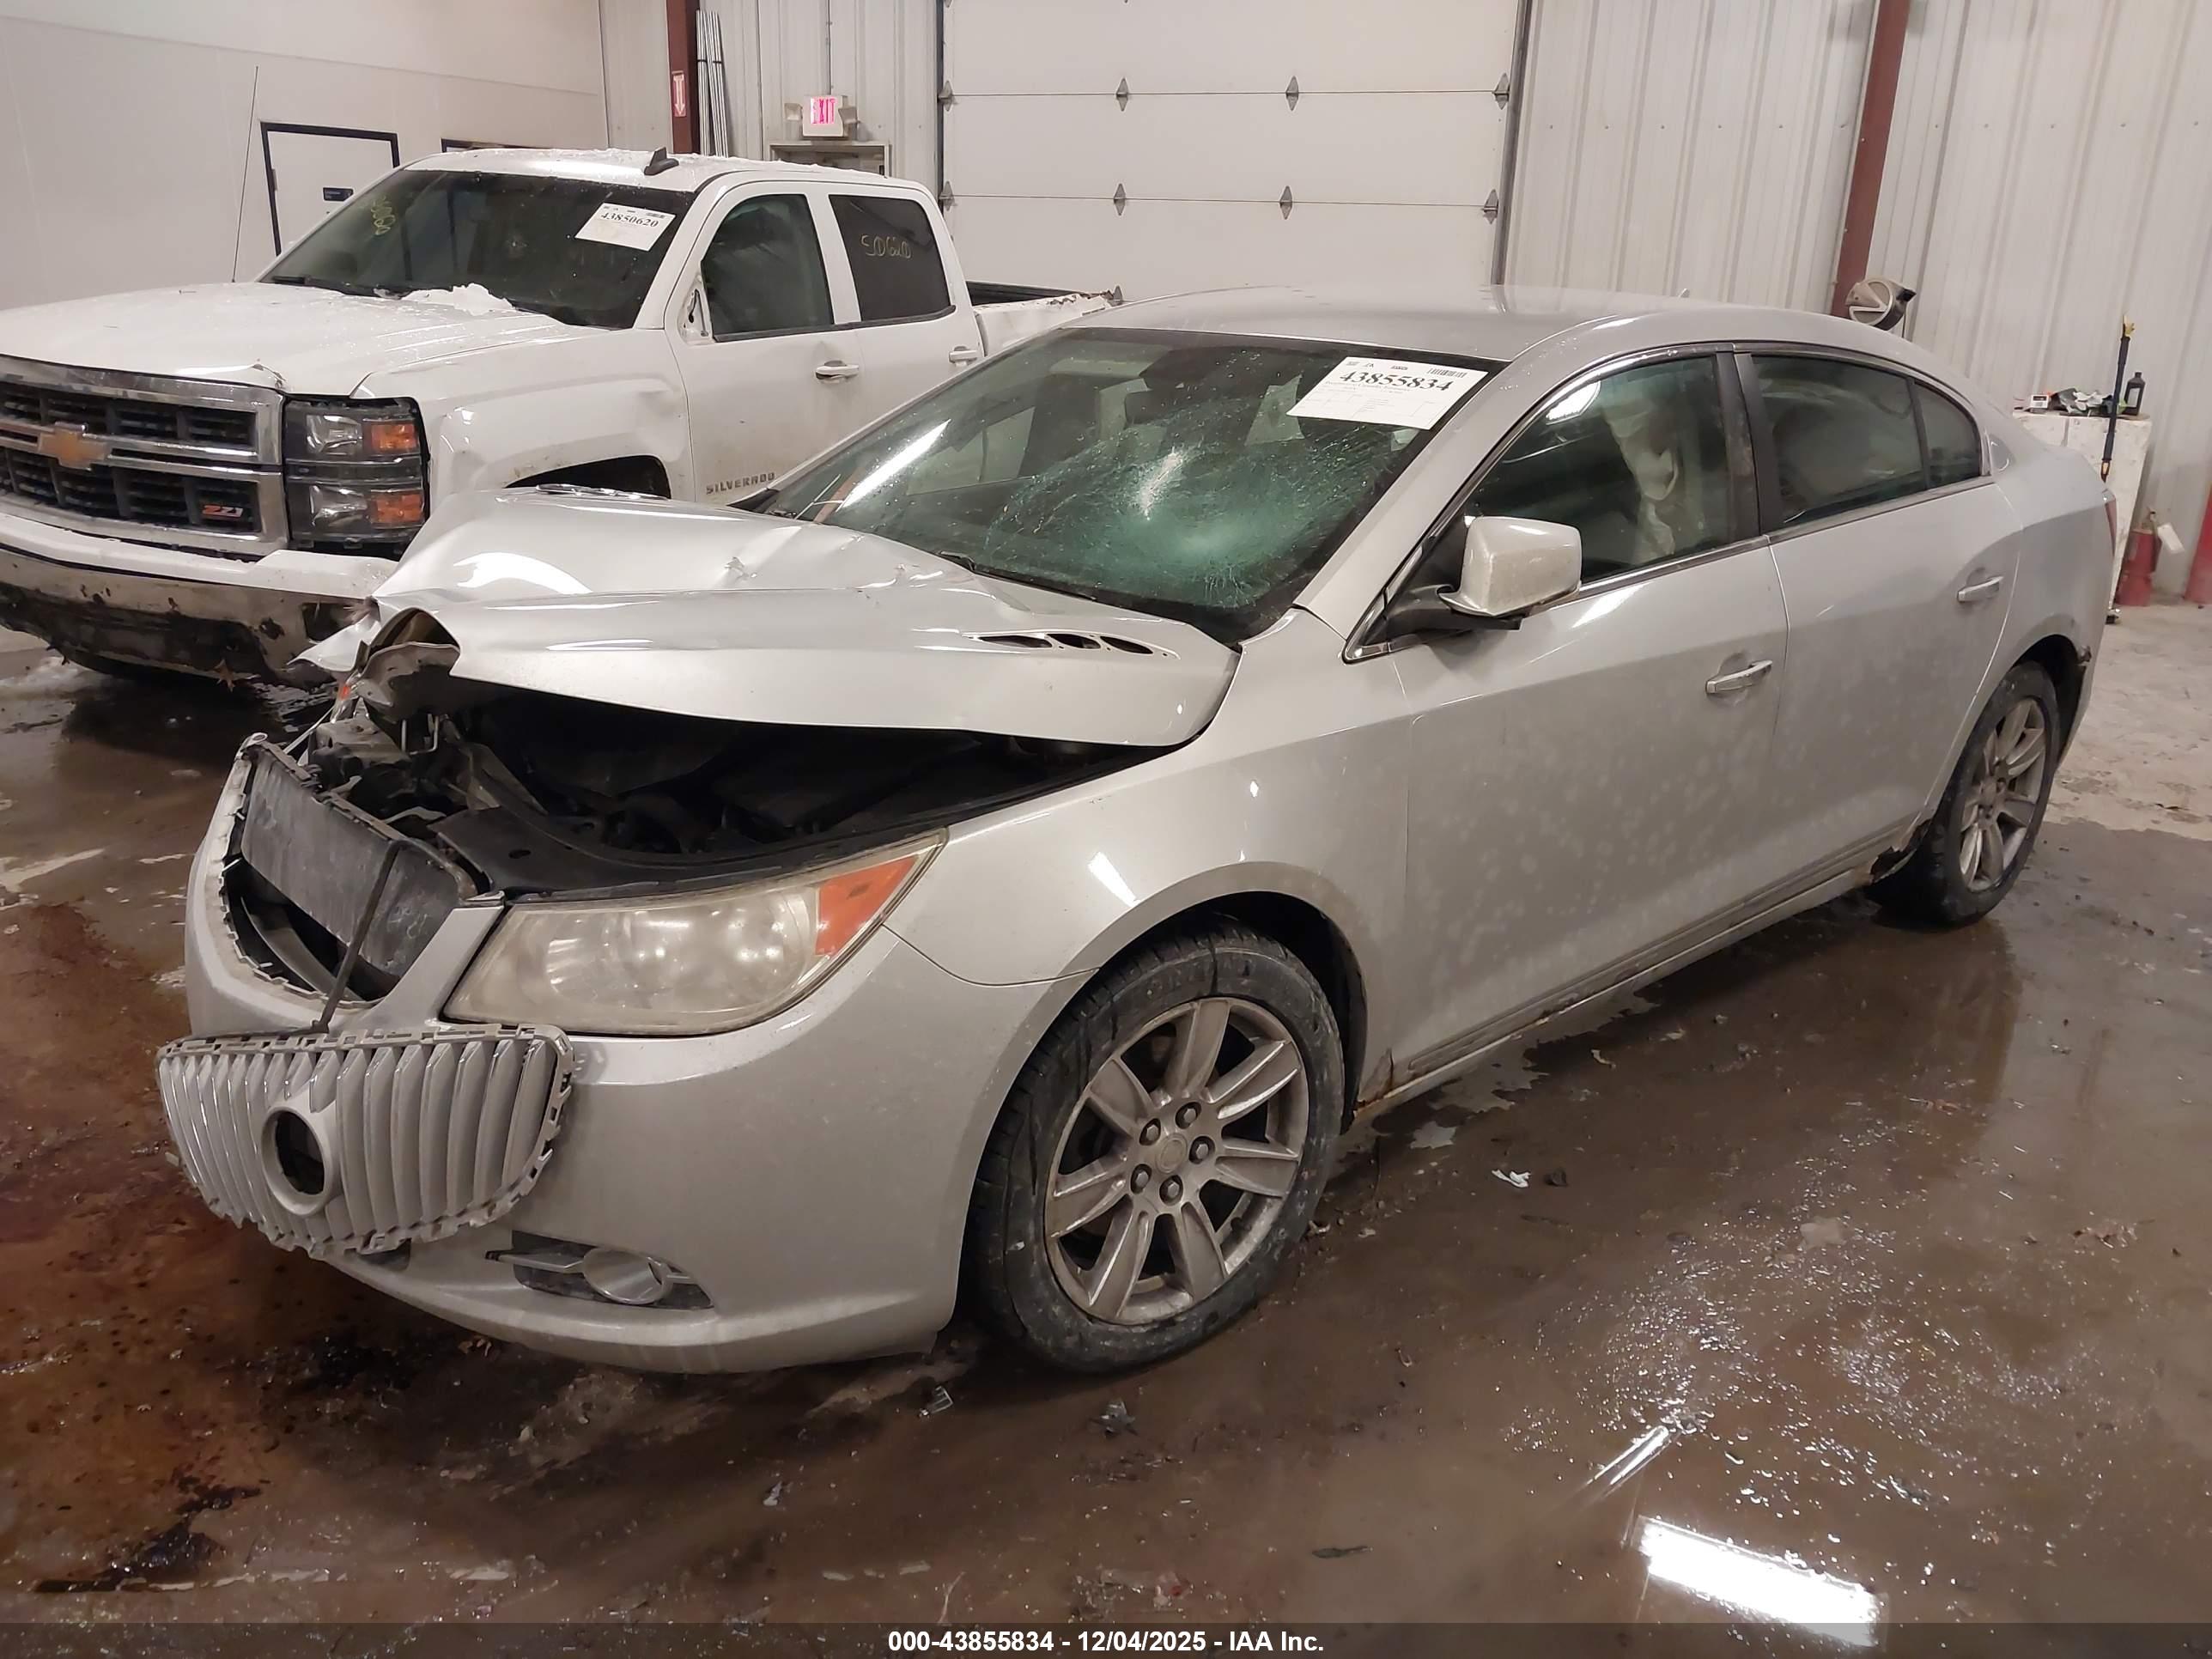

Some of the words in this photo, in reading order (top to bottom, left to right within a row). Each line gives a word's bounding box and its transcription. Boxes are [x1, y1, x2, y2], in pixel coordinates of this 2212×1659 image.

[811, 98, 836, 124] EXIT
[601, 212, 659, 227] 43850620
[1340, 370, 1454, 392] 43855834
[706, 471, 775, 495] SILVERADO
